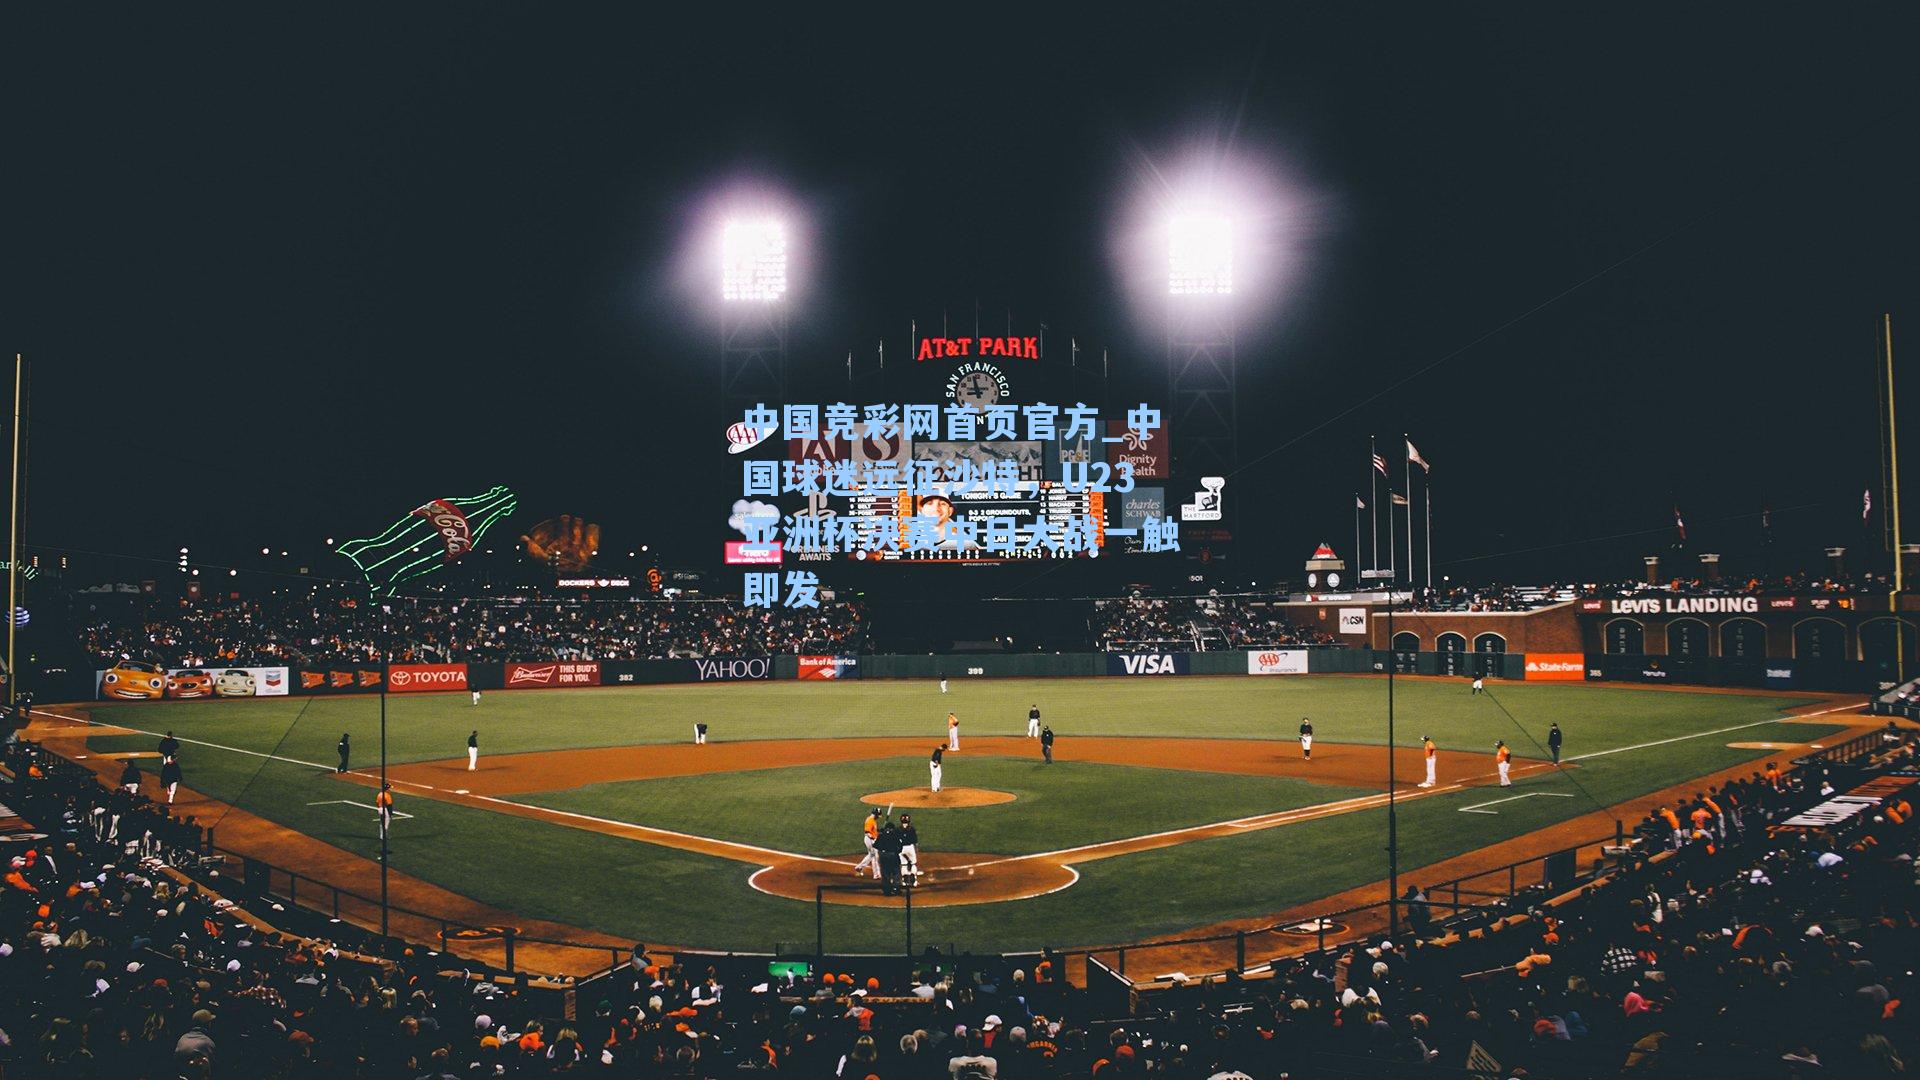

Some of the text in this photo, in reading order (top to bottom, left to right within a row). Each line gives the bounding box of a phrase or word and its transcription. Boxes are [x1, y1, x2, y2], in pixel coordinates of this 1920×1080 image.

[918, 336, 1038, 360] AT&T PARK
[946, 361, 1010, 397] SAN FRANCISCO
[1119, 454, 1157, 467] Dignity
[1125, 499, 1160, 510] charles
[798, 553, 832, 561] AWAITS
[1665, 597, 1759, 613] LANDING
[1349, 616, 1364, 625] CSN
[800, 657, 857, 666] Bank of America
[1118, 654, 1176, 675] VISA
[559, 664, 598, 673] THIS BUD'S
[695, 658, 771, 681] YAHOO!
[413, 671, 467, 683] TOYOTA
[559, 673, 590, 682] FOR YOU.
